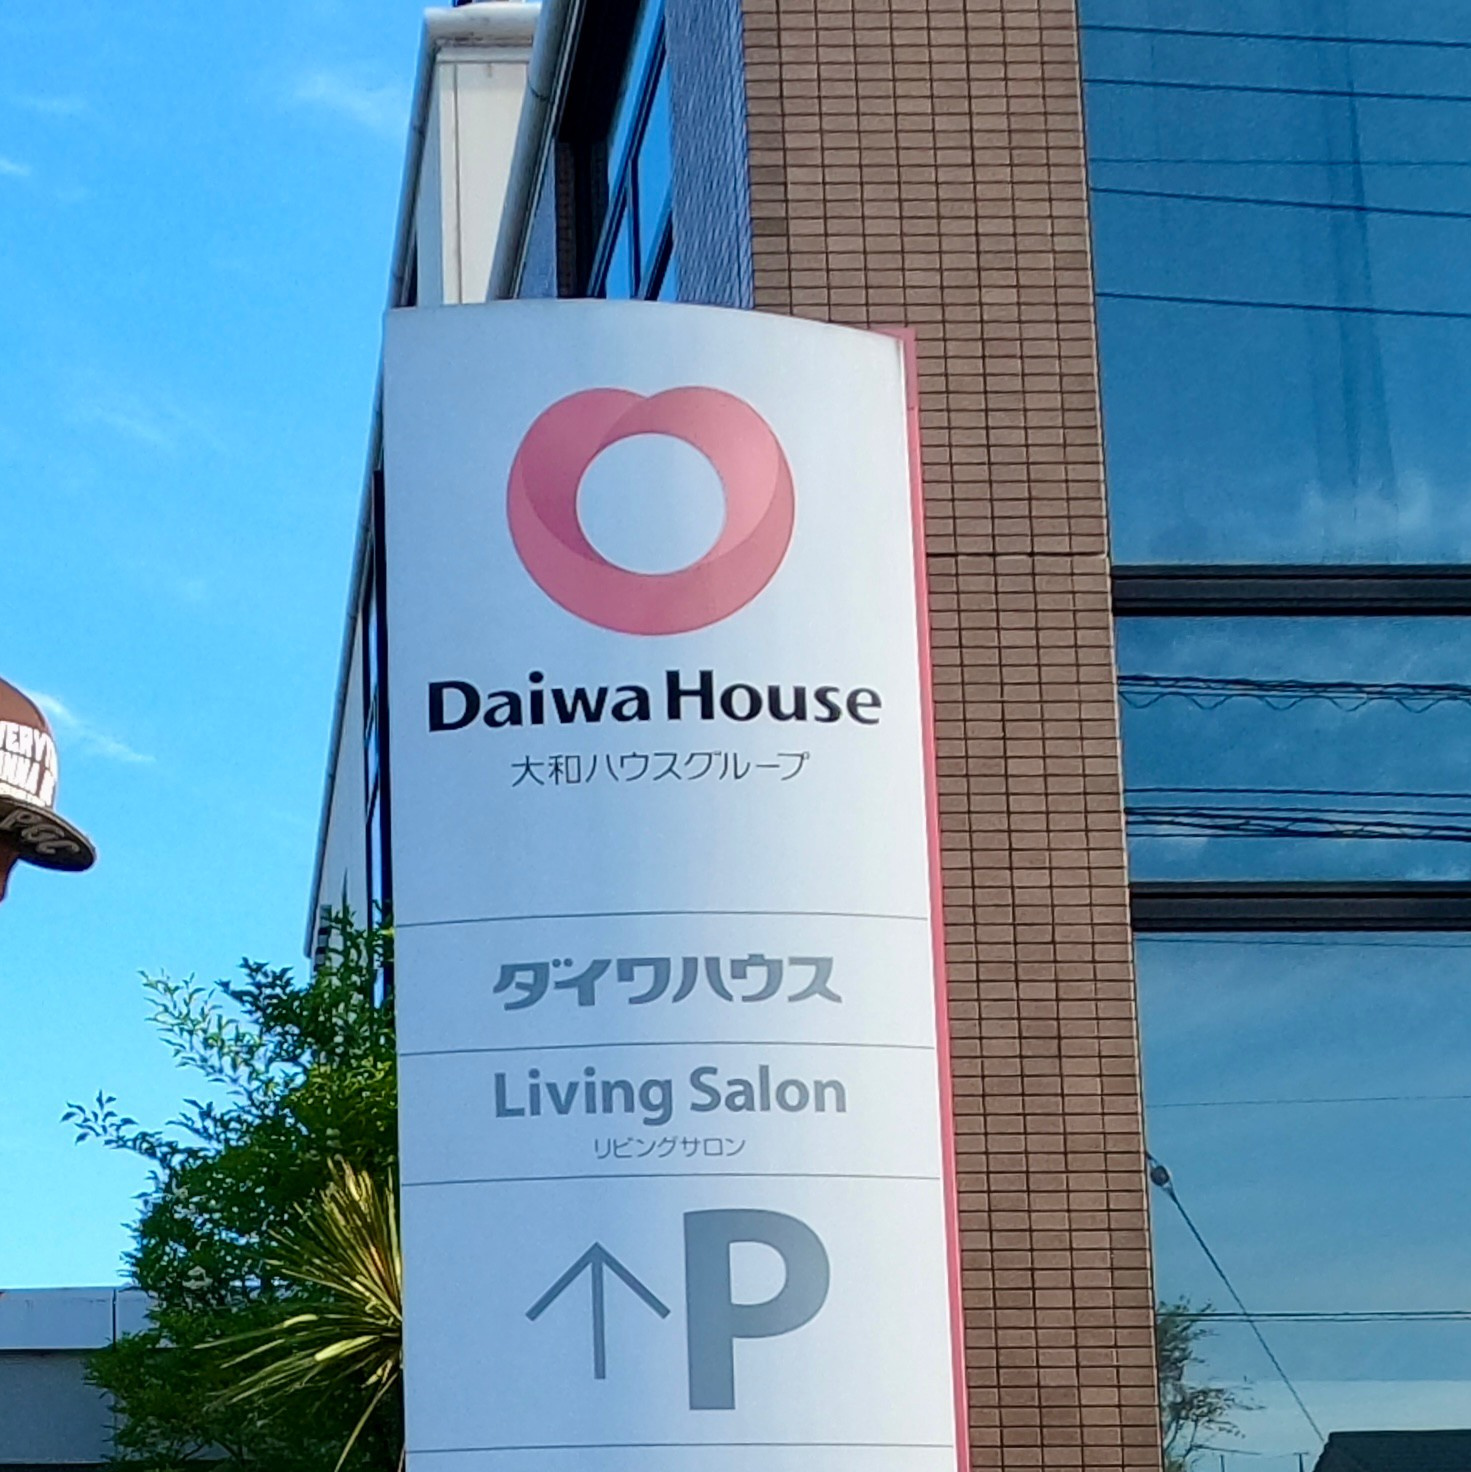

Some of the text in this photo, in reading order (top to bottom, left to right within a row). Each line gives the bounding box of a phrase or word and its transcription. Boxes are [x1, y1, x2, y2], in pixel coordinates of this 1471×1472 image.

[428, 669, 882, 732] Daiwa House
[510, 750, 811, 788] 大和ハウスグループ
[492, 953, 843, 1012] ダイワハウス
[494, 1064, 847, 1126] Living Salon
[594, 1135, 746, 1160] リビングサロン
[683, 1208, 830, 1411] P
